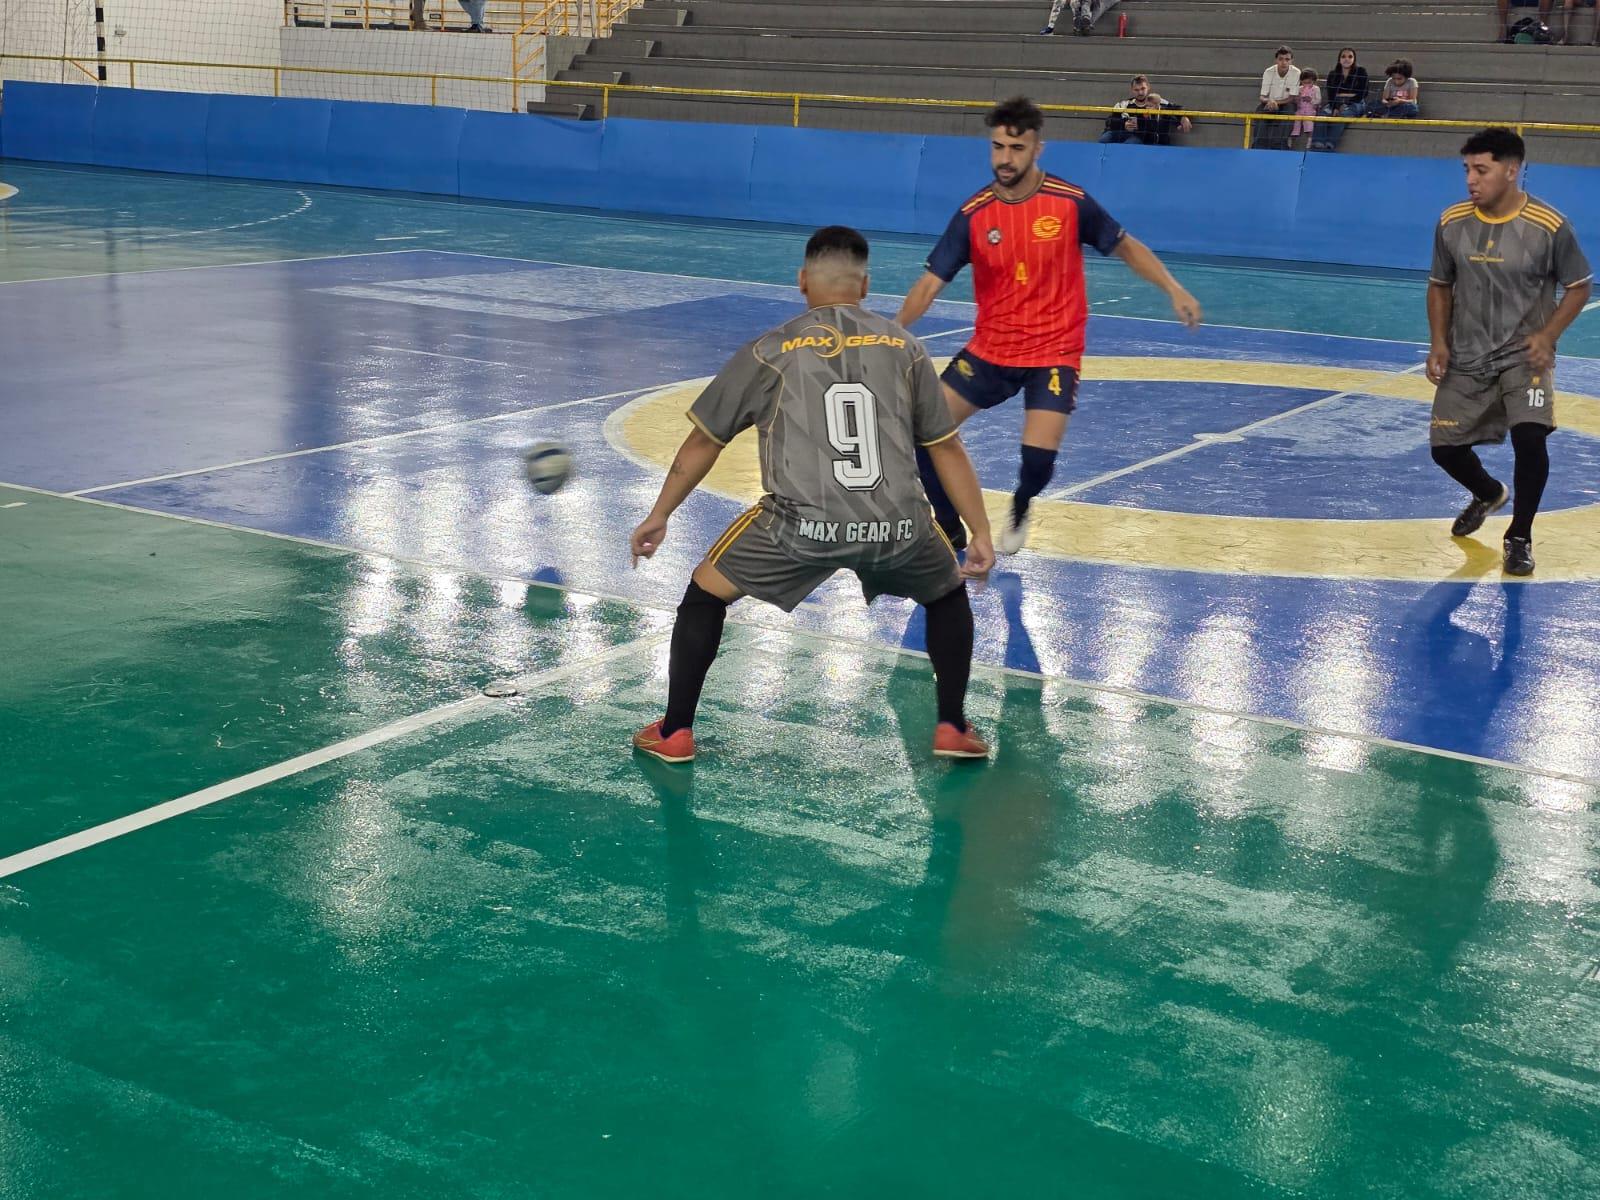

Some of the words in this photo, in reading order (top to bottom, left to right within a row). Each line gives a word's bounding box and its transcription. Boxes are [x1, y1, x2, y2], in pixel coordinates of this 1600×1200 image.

[1015, 262, 1028, 285] 4
[781, 336, 833, 353] MAX
[845, 334, 905, 349] GEAR
[1048, 374, 1062, 395] 4
[1526, 388, 1544, 407] 16
[824, 382, 883, 491] 9
[799, 517, 840, 543] MAX
[845, 521, 891, 542] GEAR
[896, 518, 913, 541] FC
